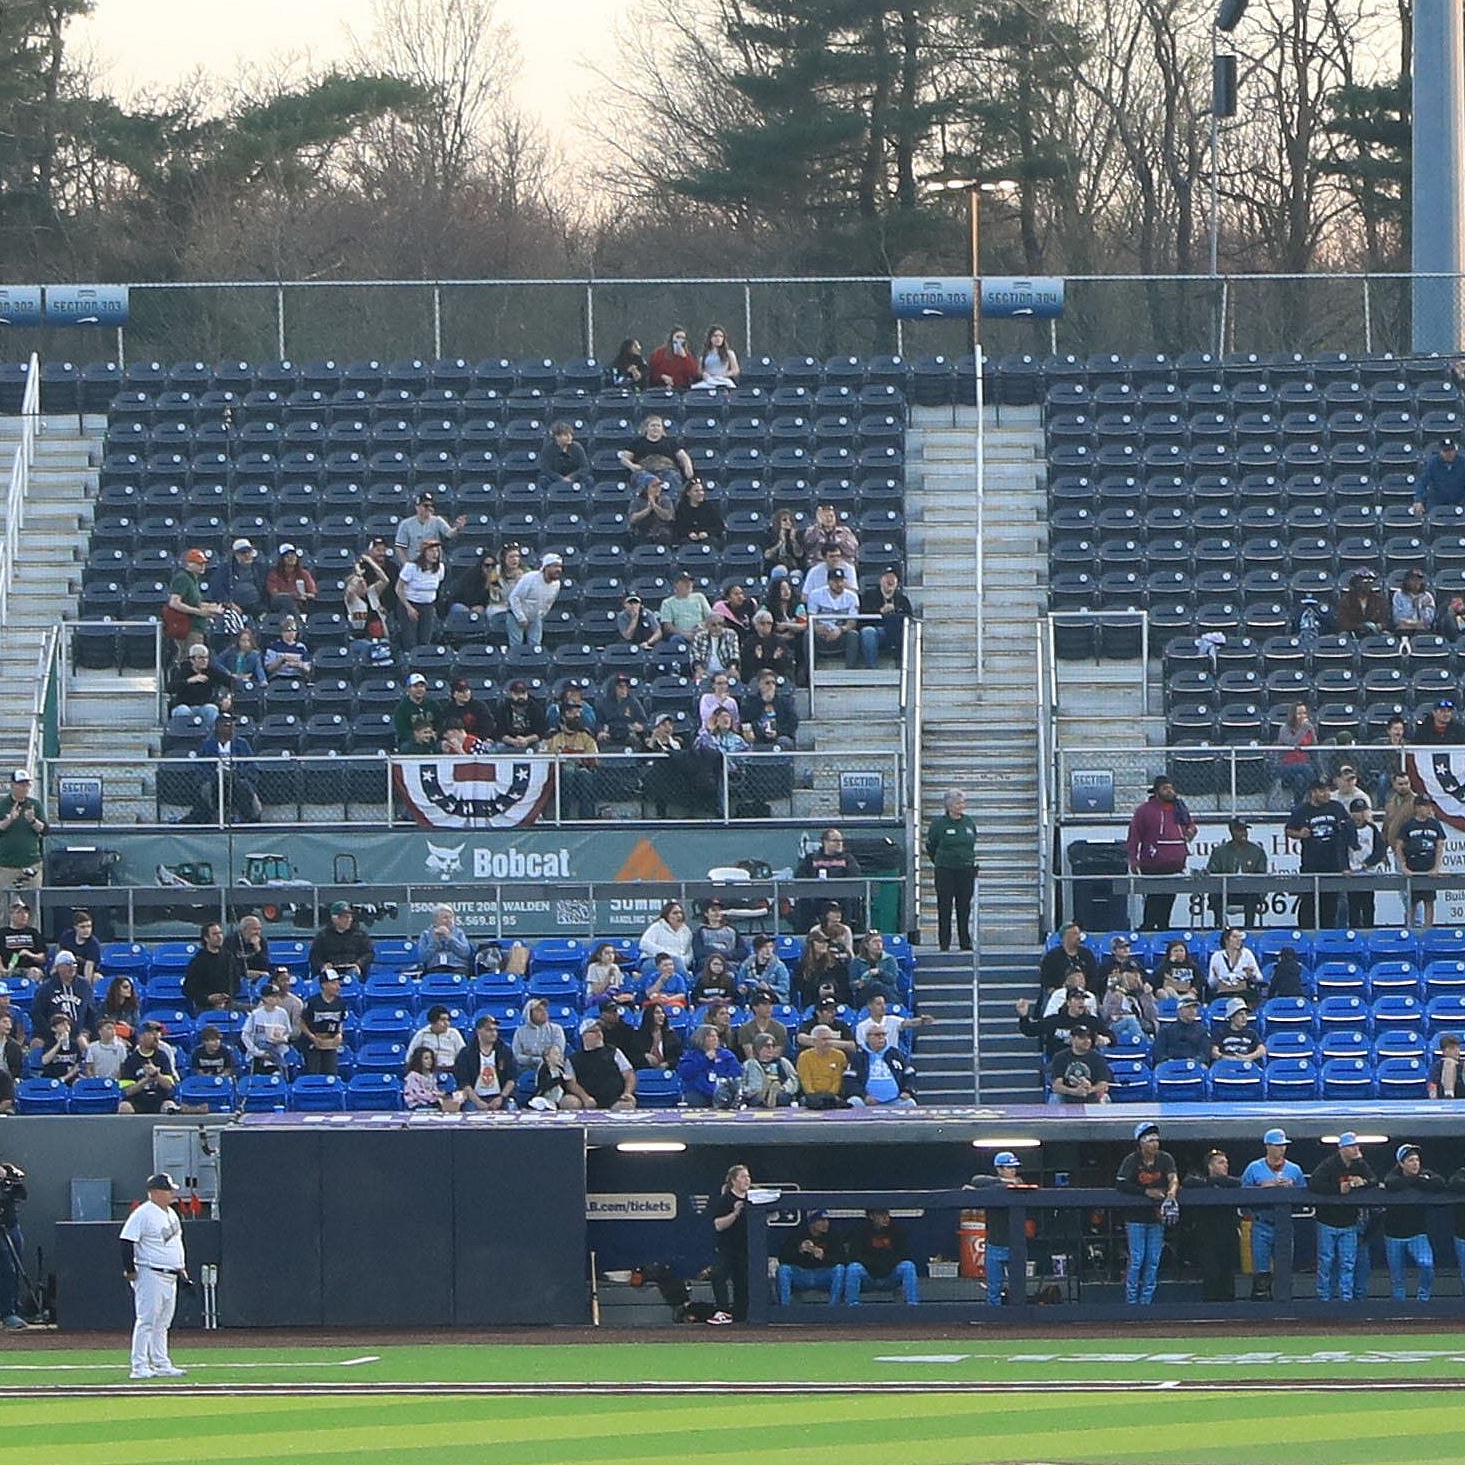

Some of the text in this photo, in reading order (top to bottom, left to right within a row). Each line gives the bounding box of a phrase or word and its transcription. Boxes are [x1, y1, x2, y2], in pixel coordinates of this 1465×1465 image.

[473, 847, 571, 878] Bobcat
[502, 901, 550, 912] WALDEN
[586, 1199, 672, 1215] B.com/tickets
